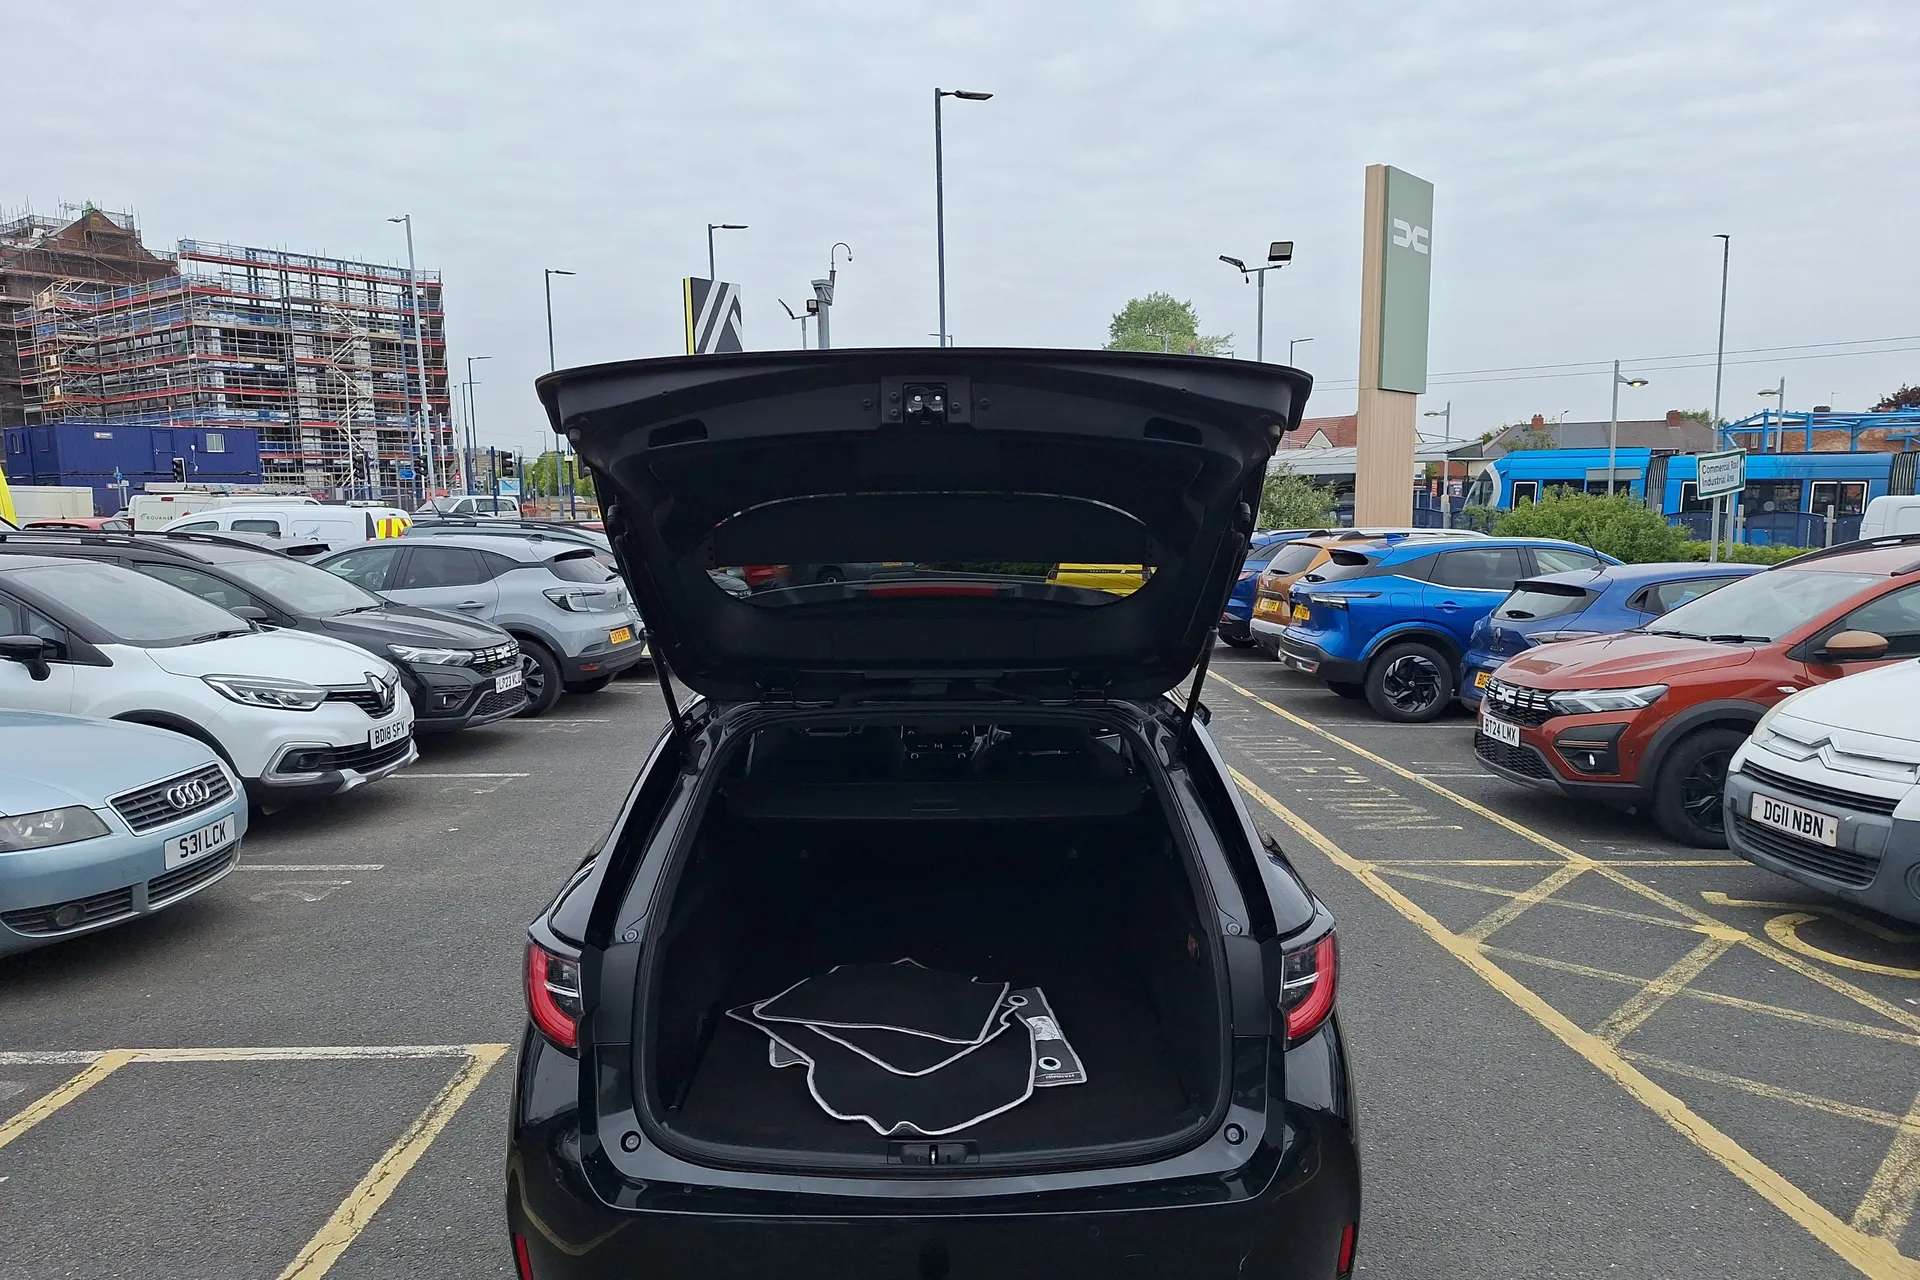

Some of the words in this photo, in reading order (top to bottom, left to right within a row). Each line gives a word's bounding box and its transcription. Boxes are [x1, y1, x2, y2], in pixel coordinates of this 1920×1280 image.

[1702, 461, 1730, 475] Commercial
[1702, 474, 1726, 488] Industrial
[375, 726, 392, 744] BD18
[393, 720, 405, 738] SFY
[1485, 718, 1500, 736] BT24
[1502, 724, 1516, 743] LMX
[1763, 800, 1789, 827] DG11
[1792, 809, 1824, 838] NBN
[180, 831, 202, 858] S31
[204, 821, 226, 849] LCK
